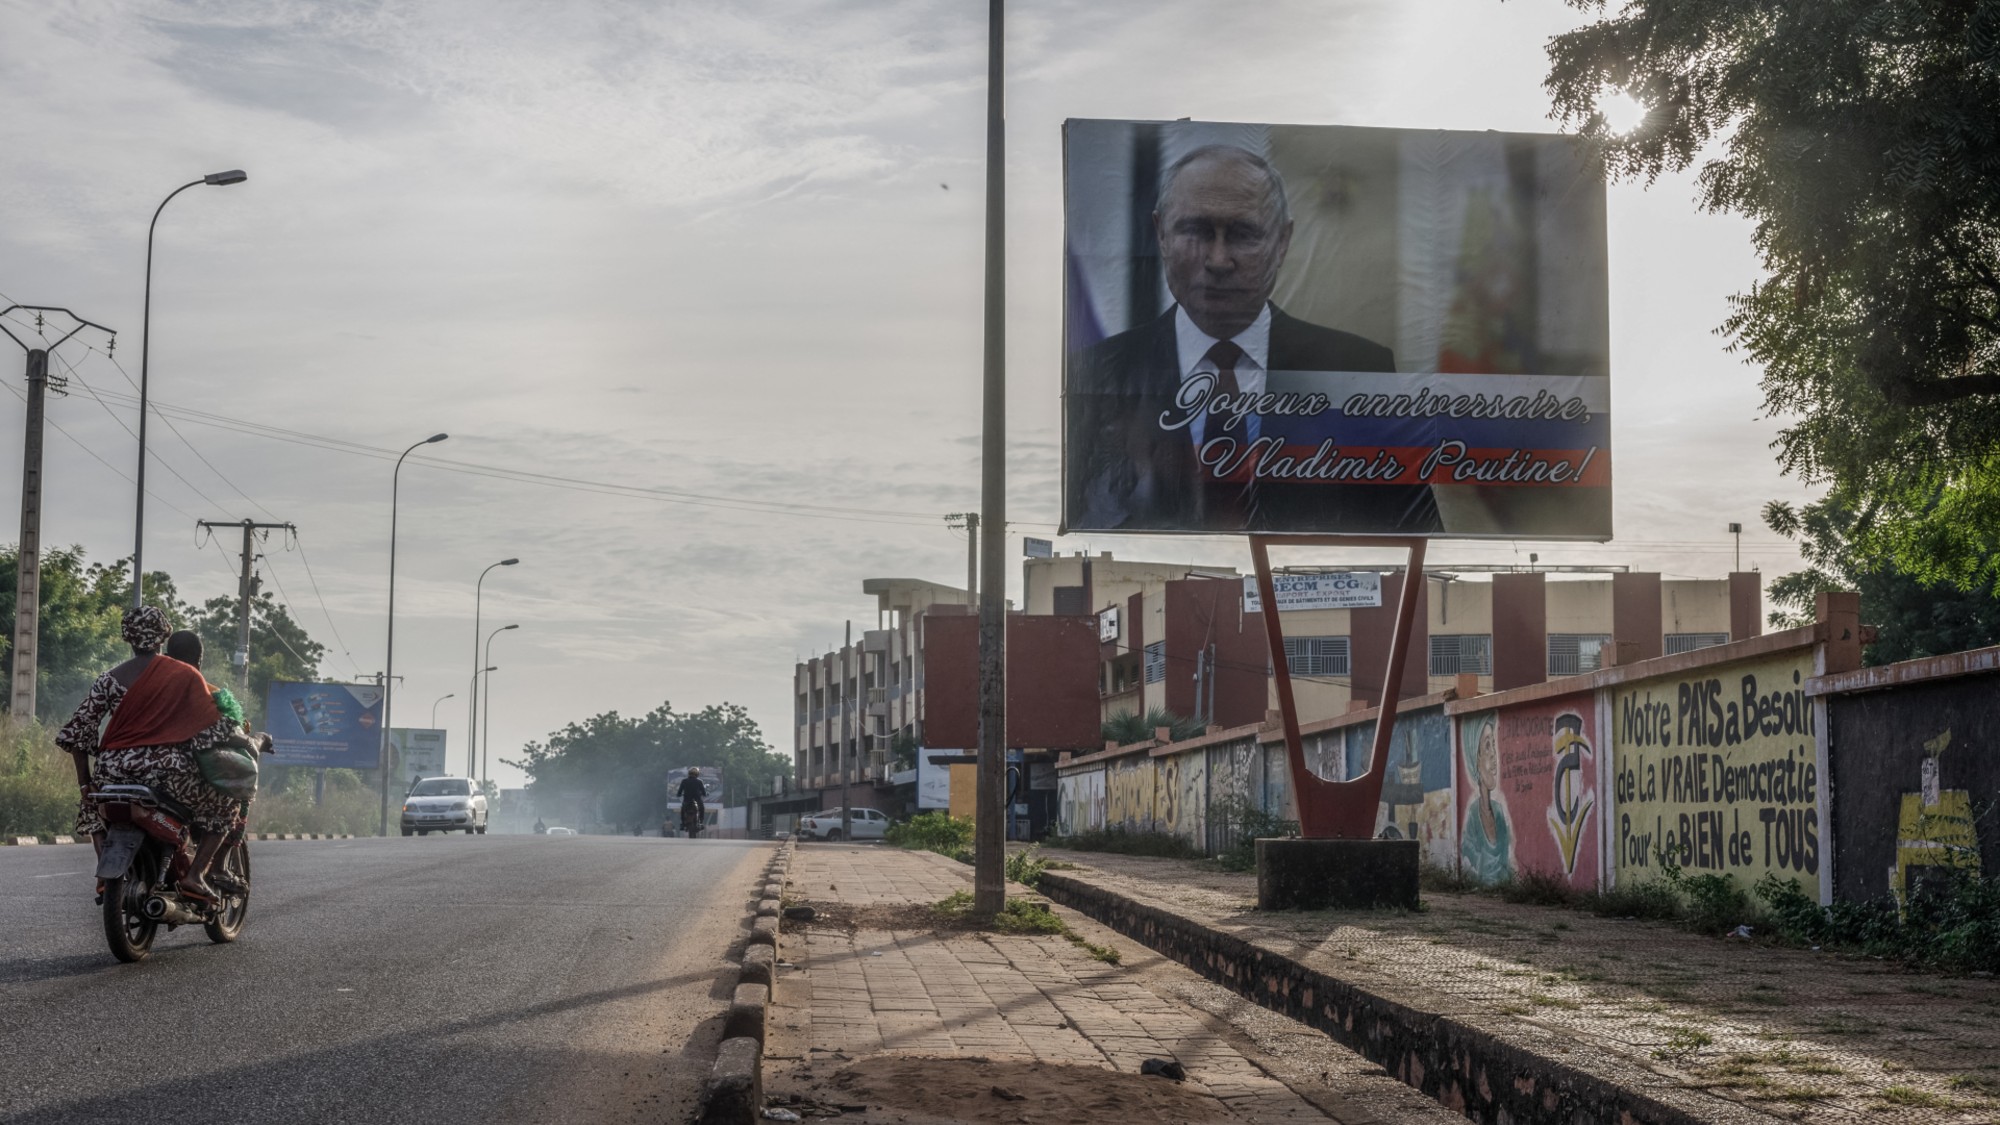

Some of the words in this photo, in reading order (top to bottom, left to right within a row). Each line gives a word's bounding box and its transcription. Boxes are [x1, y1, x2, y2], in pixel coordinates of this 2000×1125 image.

[1159, 372, 1329, 431] Joyeux
[1343, 387, 1592, 424] anniversaire,
[1200, 436, 1406, 480] Vladimir
[1420, 438, 1597, 482] Poutine!
[1621, 690, 1671, 748] Notre
[1677, 678, 1724, 748] PAYS
[1725, 699, 1742, 747] a
[1741, 669, 1816, 741] Besoin
[1617, 754, 1635, 804] de
[1661, 752, 1709, 803] VRAIE
[1712, 744, 1817, 807] Démocratie
[1621, 812, 1651, 869] Pour
[1679, 810, 1725, 870] BIEN
[1728, 807, 1753, 867] de
[1759, 807, 1820, 876] TOUS
